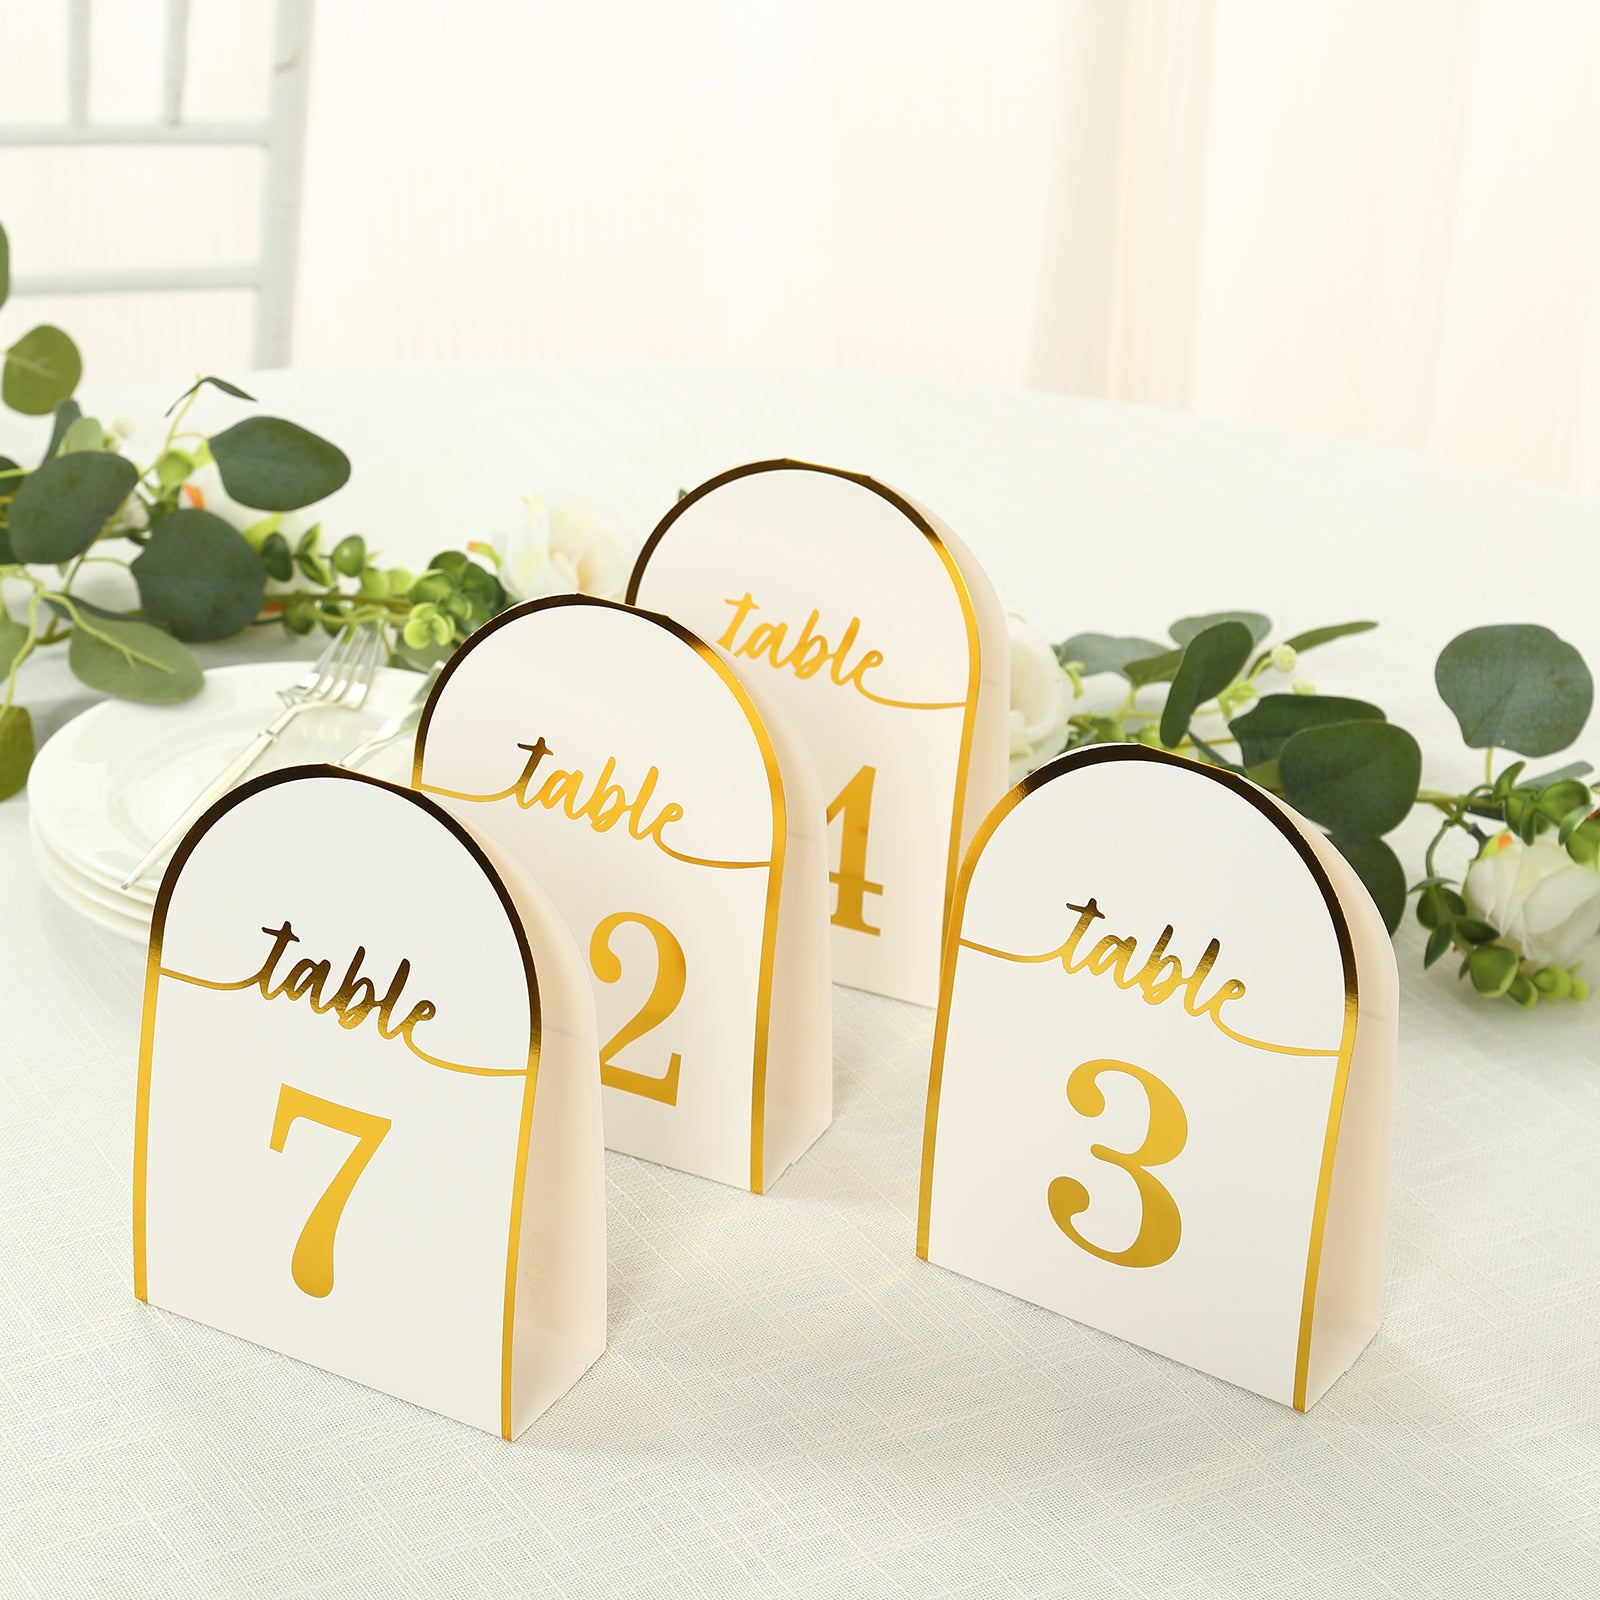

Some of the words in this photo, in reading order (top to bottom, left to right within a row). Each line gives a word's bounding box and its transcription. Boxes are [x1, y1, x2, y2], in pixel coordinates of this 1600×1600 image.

[716, 592, 884, 690] table
[516, 736, 684, 842] table
[825, 764, 884, 937] 4
[256, 921, 438, 1043] table
[589, 911, 687, 1107] 2
[1062, 897, 1246, 1021] table
[269, 1083, 392, 1299] 7
[1047, 1058, 1189, 1268] 3
